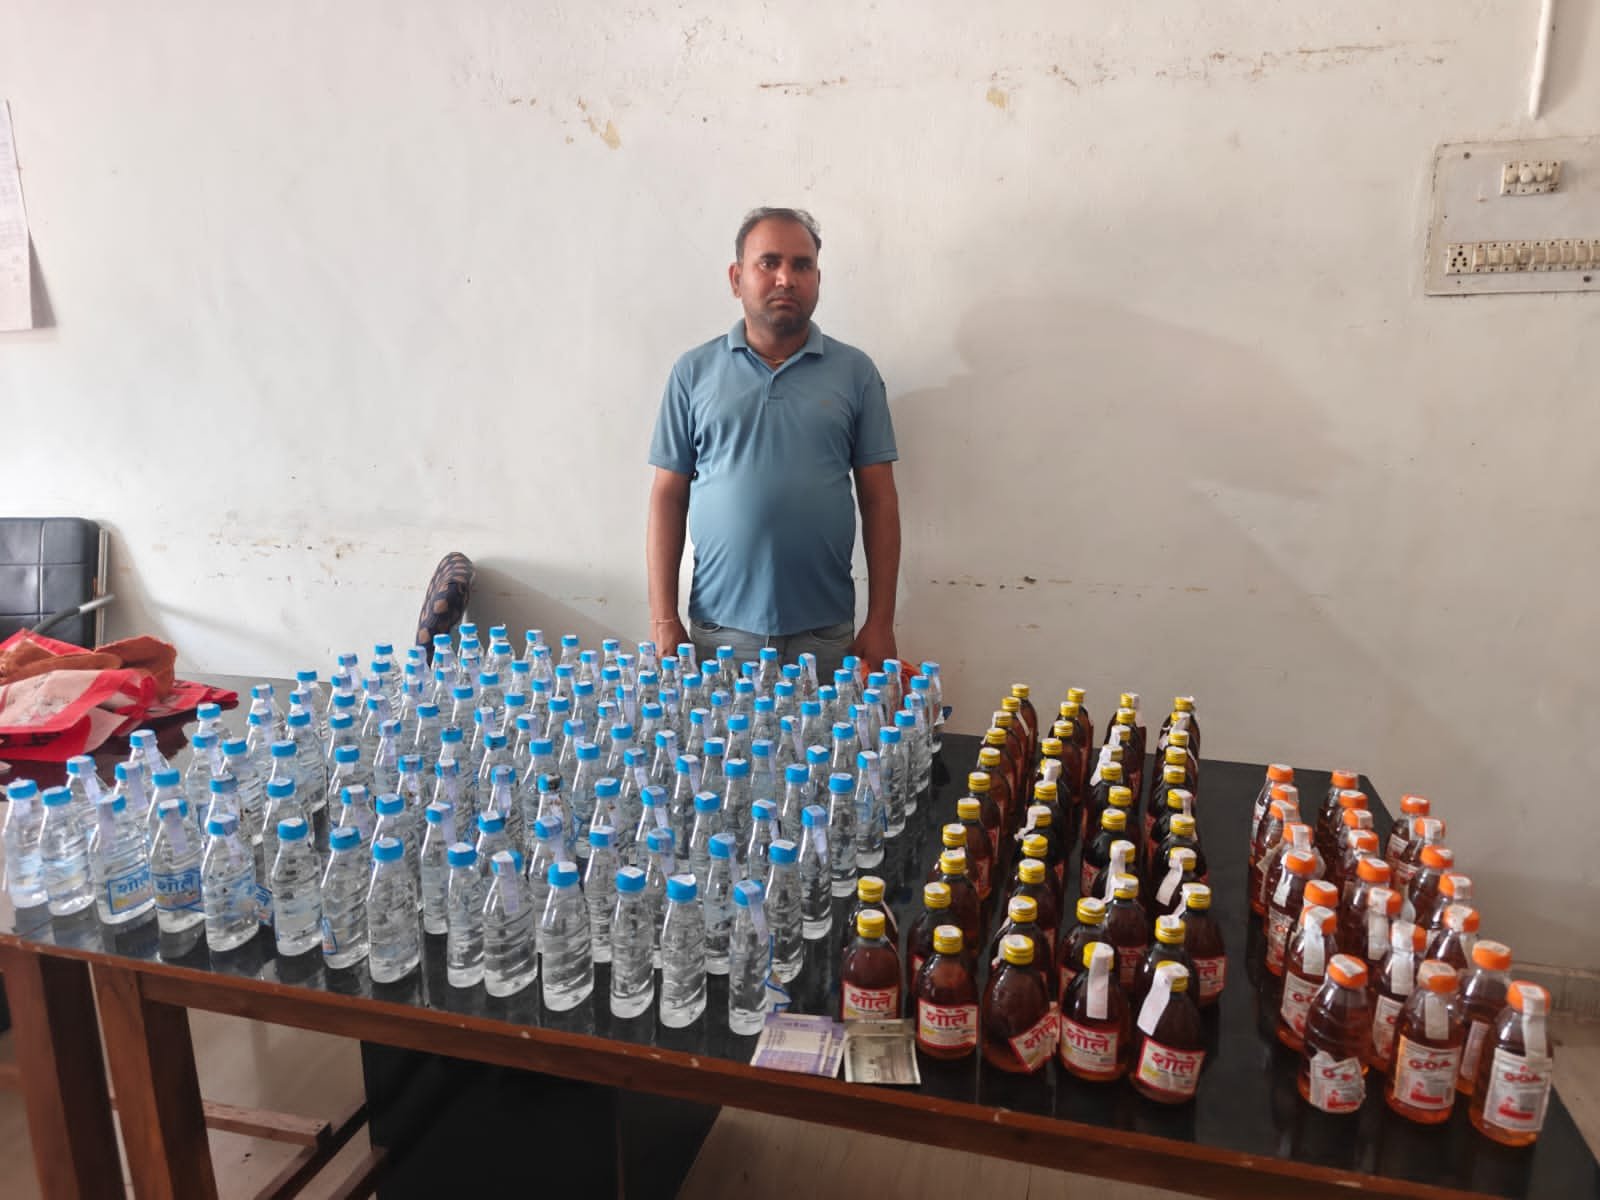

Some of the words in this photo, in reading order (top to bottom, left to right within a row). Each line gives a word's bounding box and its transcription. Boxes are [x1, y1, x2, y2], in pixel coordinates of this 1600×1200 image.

[849, 990, 892, 1010] शोले
[925, 1007, 969, 1027] शोले
[1065, 1028, 1110, 1052] शोले
[1151, 1051, 1196, 1074] शोले
